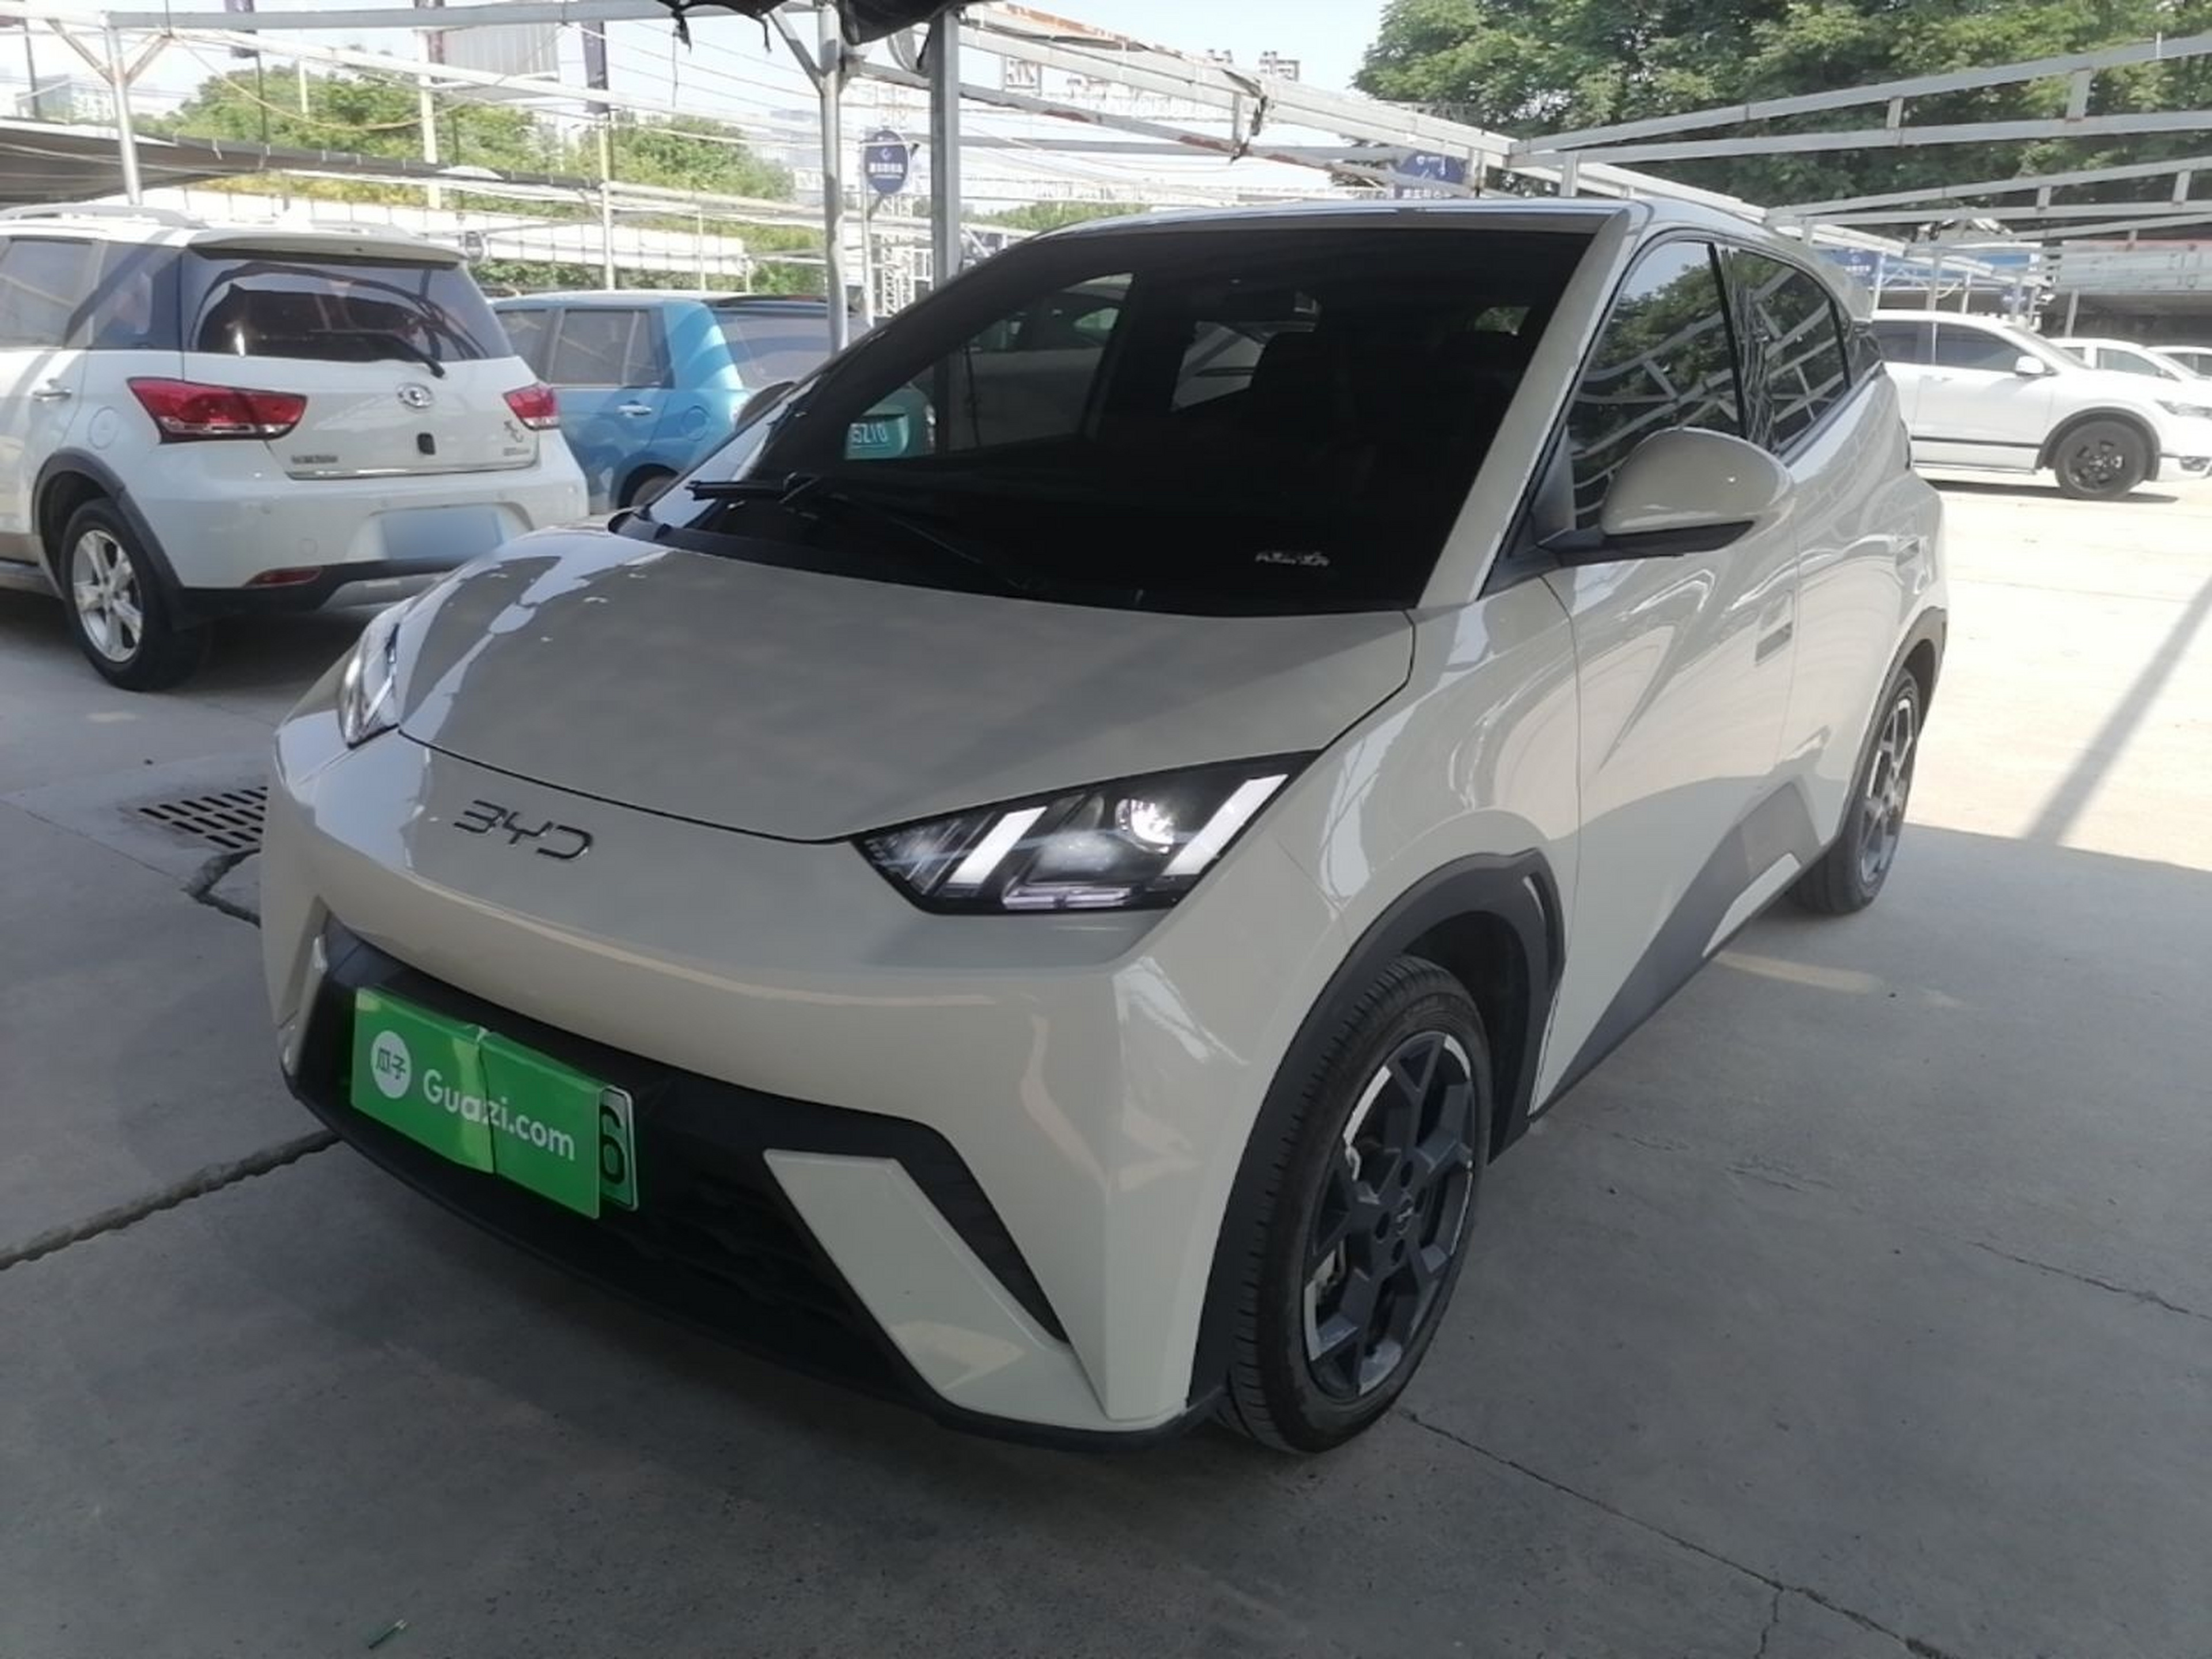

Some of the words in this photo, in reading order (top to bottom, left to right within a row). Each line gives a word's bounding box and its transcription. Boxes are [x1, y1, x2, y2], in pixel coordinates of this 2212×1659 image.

[453, 799, 593, 859] BYD
[375, 1047, 407, 1081] 瓜子
[423, 1068, 575, 1162] Guazi.com
[599, 1104, 626, 1185] 6
